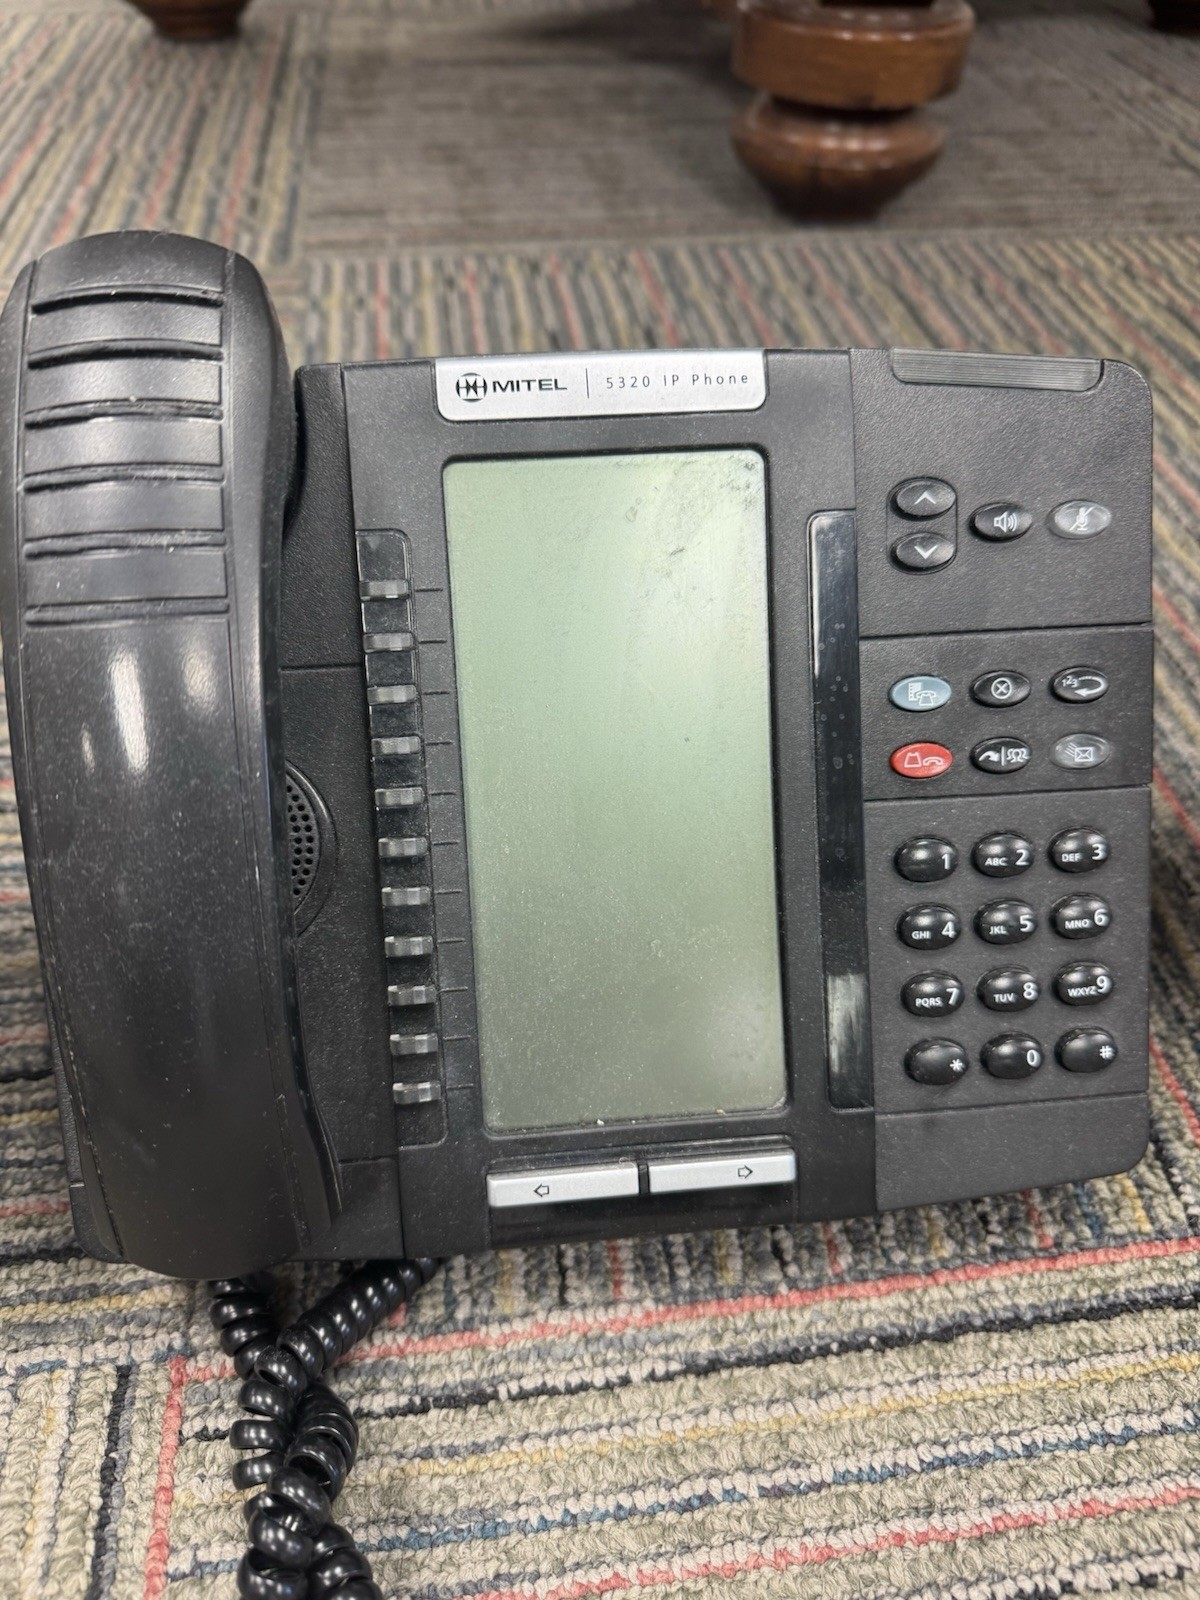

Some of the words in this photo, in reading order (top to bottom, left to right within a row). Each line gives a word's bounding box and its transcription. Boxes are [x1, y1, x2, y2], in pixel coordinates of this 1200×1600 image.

[492, 378, 567, 393] MITEL
[606, 375, 651, 389] 5320
[663, 373, 680, 387] IP
[692, 372, 749, 386] Phone
[941, 853, 951, 870] 1
[985, 857, 1007, 866] ABC
[1015, 849, 1029, 866] 2
[1061, 853, 1082, 863] DEF
[1091, 844, 1104, 861] 3
[989, 926, 1007, 935] JKL
[1019, 915, 1034, 932] 5
[1064, 919, 1090, 929] MNO
[1094, 908, 1107, 926] 6
[911, 930, 931, 940] GHI
[942, 921, 956, 938] 4
[993, 993, 1015, 1003] TUV
[1023, 982, 1036, 1000] 8
[1067, 986, 1096, 997] WXYZ
[1096, 975, 1110, 993] 9
[915, 997, 942, 1008] PQRS
[946, 988, 960, 1005] 7
[1026, 1049, 1040, 1067] 0
